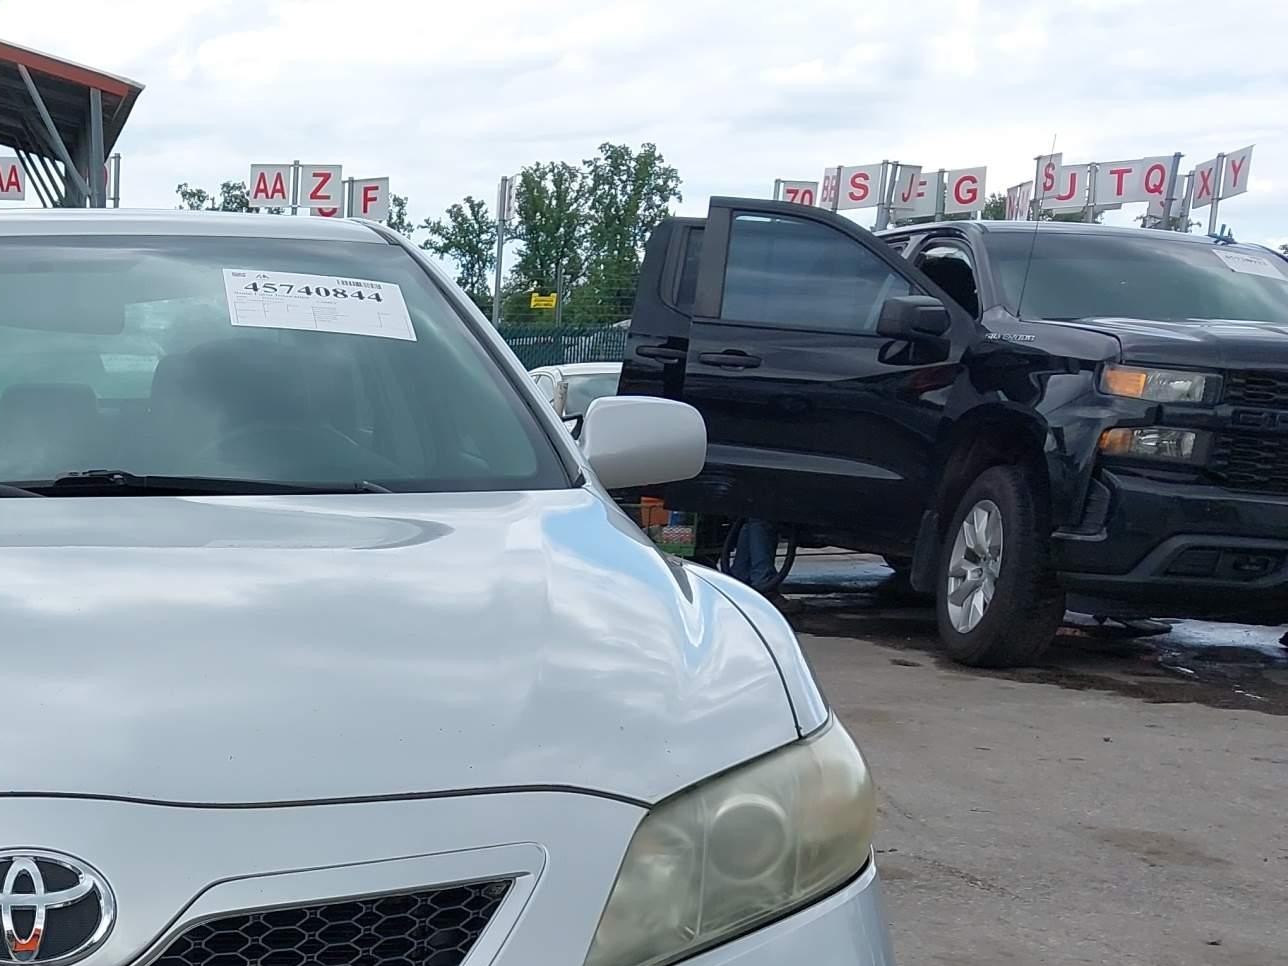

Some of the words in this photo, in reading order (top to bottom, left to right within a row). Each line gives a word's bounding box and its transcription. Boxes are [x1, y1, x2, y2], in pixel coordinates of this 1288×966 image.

[253, 171, 287, 200] AA
[309, 172, 332, 200] Z
[1042, 162, 1056, 192] S
[1055, 172, 1077, 201] J
[1109, 167, 1133, 196] T
[1144, 163, 1166, 196] Q
[1197, 167, 1214, 200] X
[1230, 155, 1247, 188] Y
[362, 185, 379, 214] F
[848, 172, 870, 202] S
[901, 173, 915, 203] J
[953, 175, 979, 206] G
[243, 281, 384, 303] 45740844
